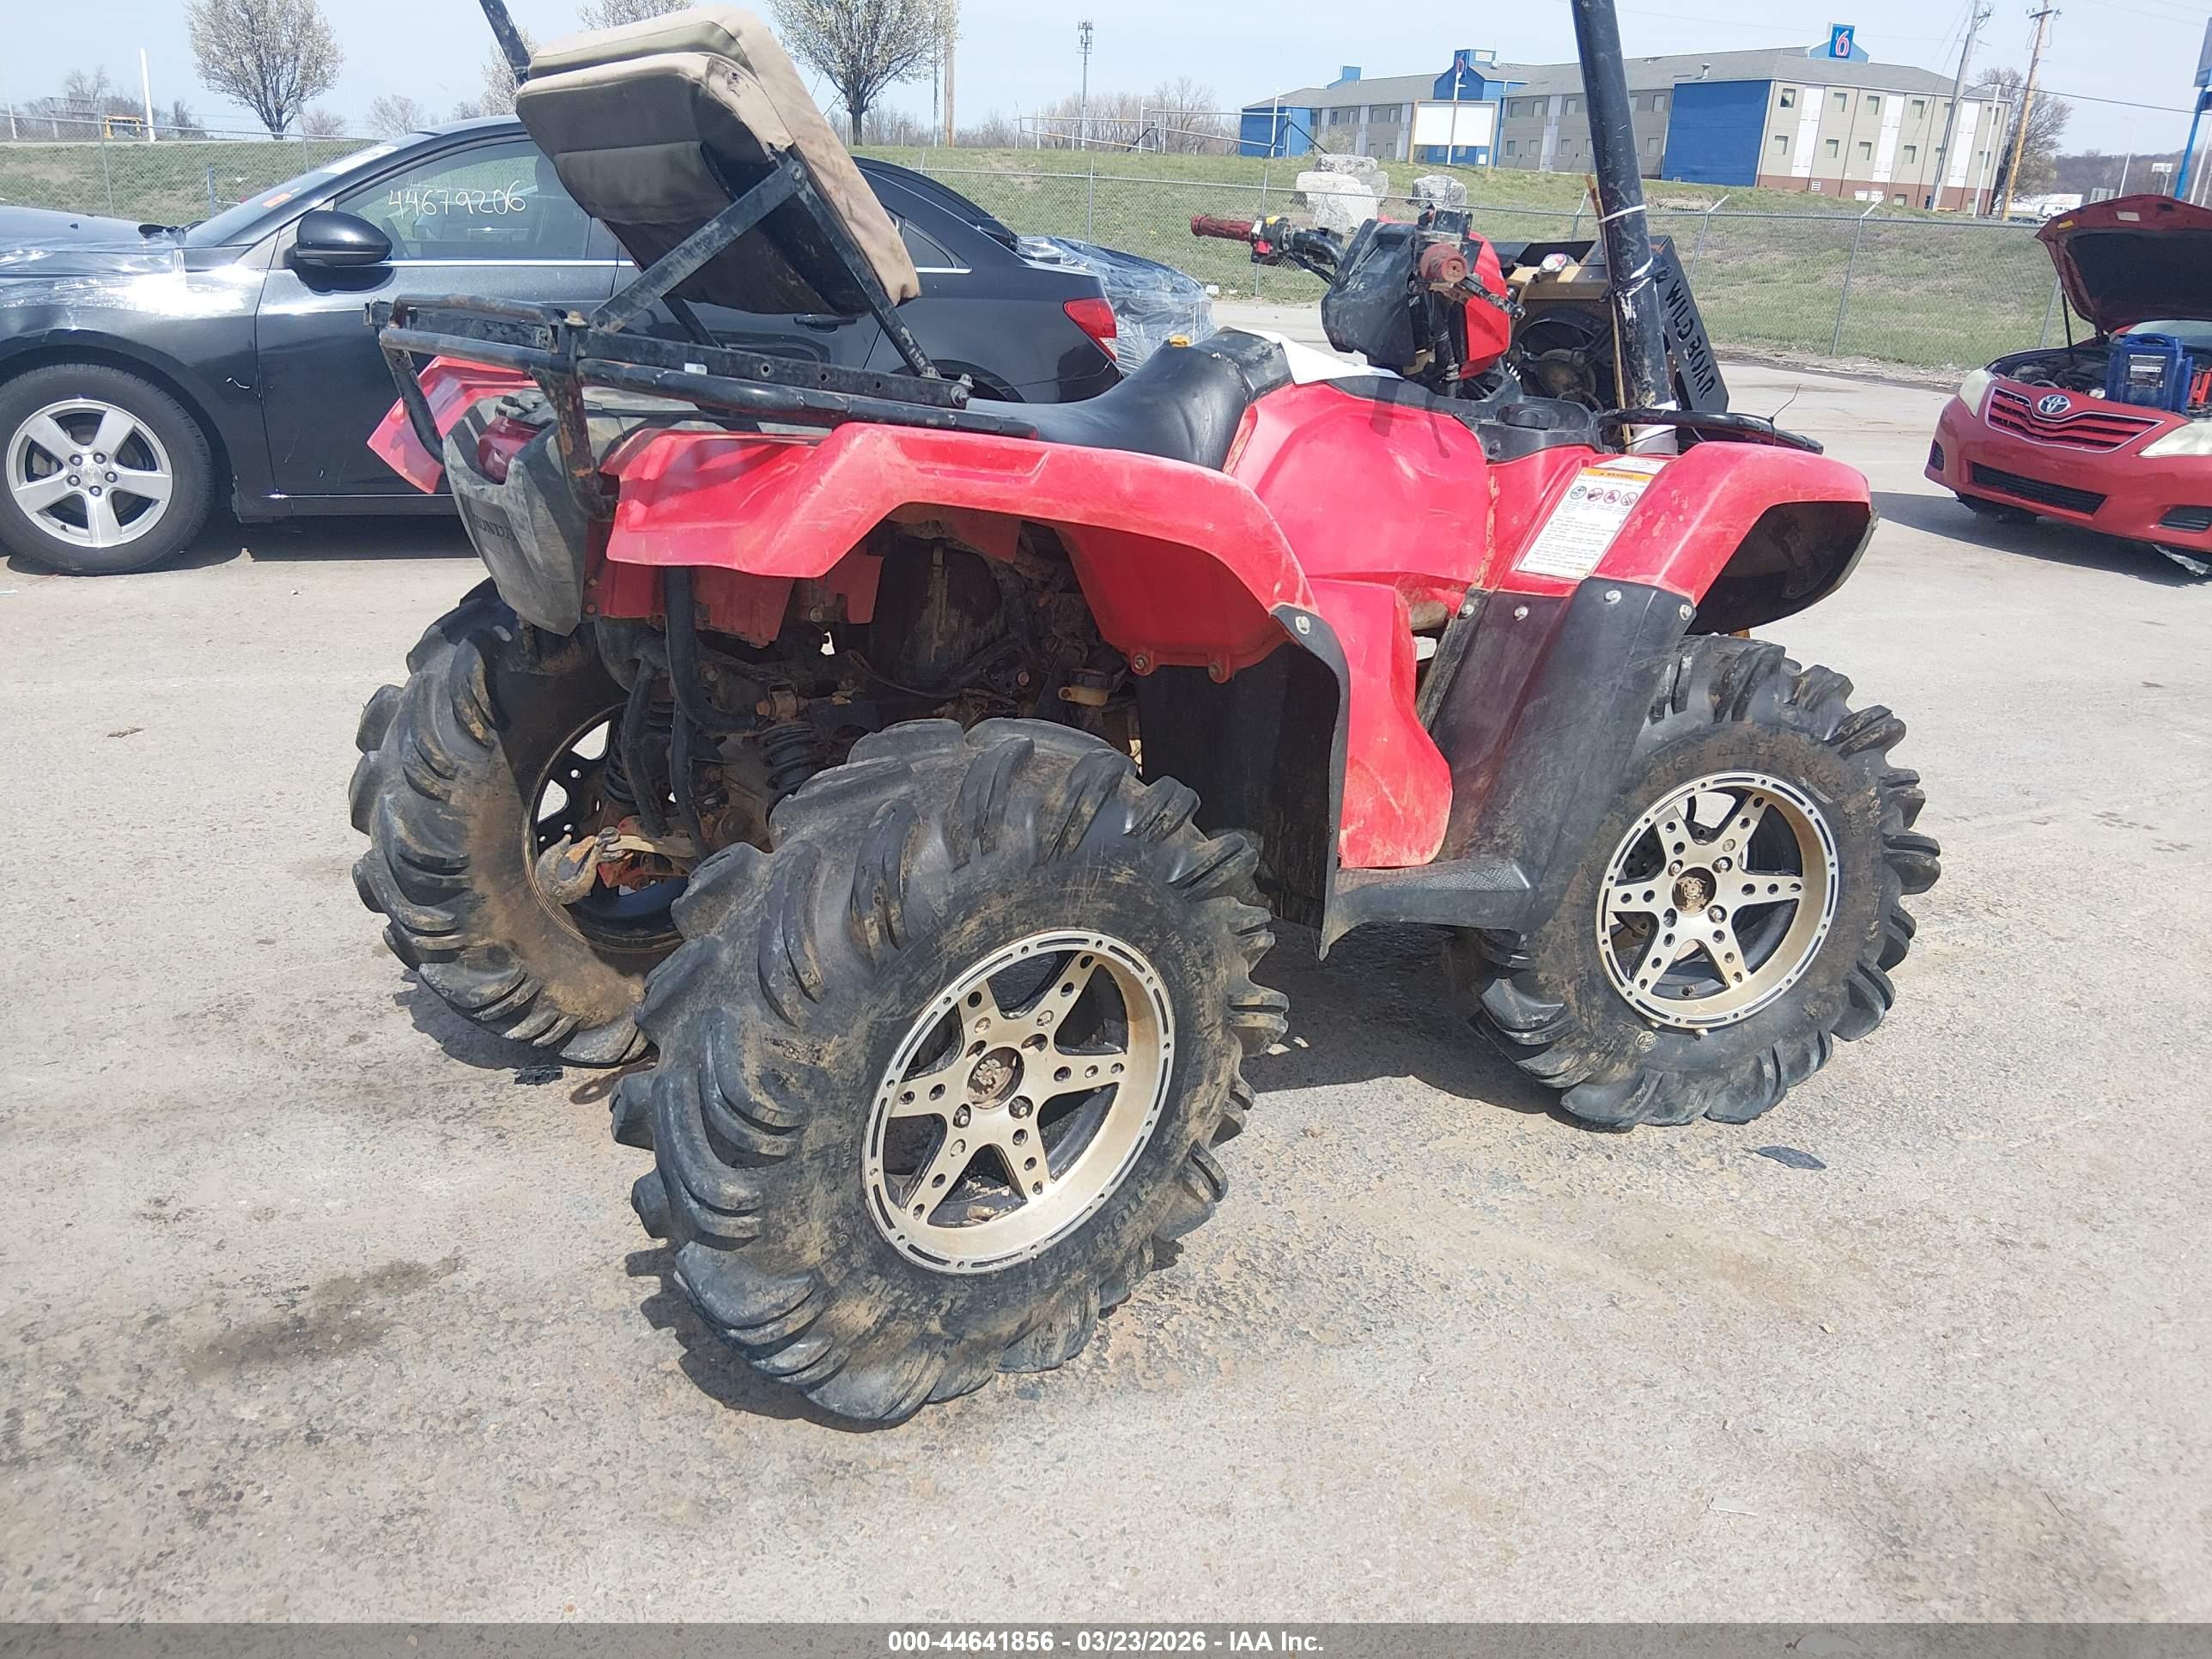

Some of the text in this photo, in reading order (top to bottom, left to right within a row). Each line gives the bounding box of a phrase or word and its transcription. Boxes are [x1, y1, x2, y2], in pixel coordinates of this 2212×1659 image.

[1835, 30, 1850, 57] 6
[389, 179, 526, 219] 44679206
[1666, 279, 1717, 400] WILD BOAR
